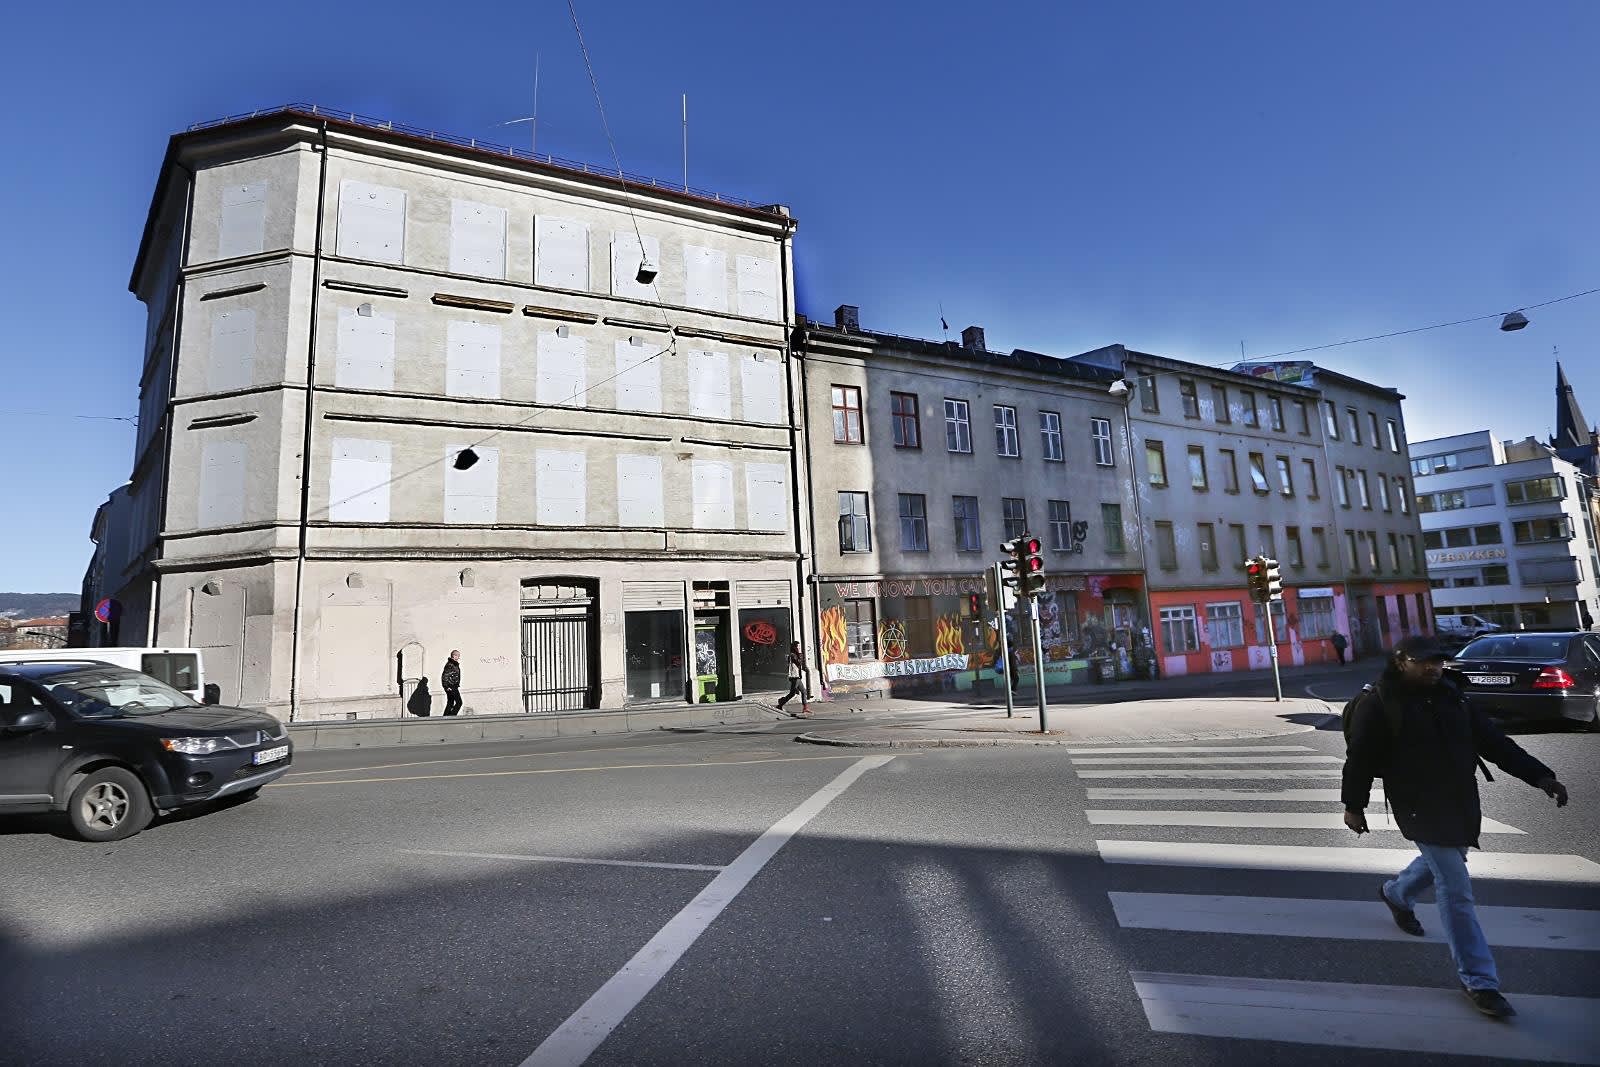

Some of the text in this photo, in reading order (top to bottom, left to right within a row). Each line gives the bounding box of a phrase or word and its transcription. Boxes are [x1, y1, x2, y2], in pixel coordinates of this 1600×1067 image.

[835, 581, 859, 598] WE
[865, 579, 915, 598] KNOW
[922, 579, 959, 596] YOUR
[835, 653, 966, 679] RESISTANCE IS PRICELESS
